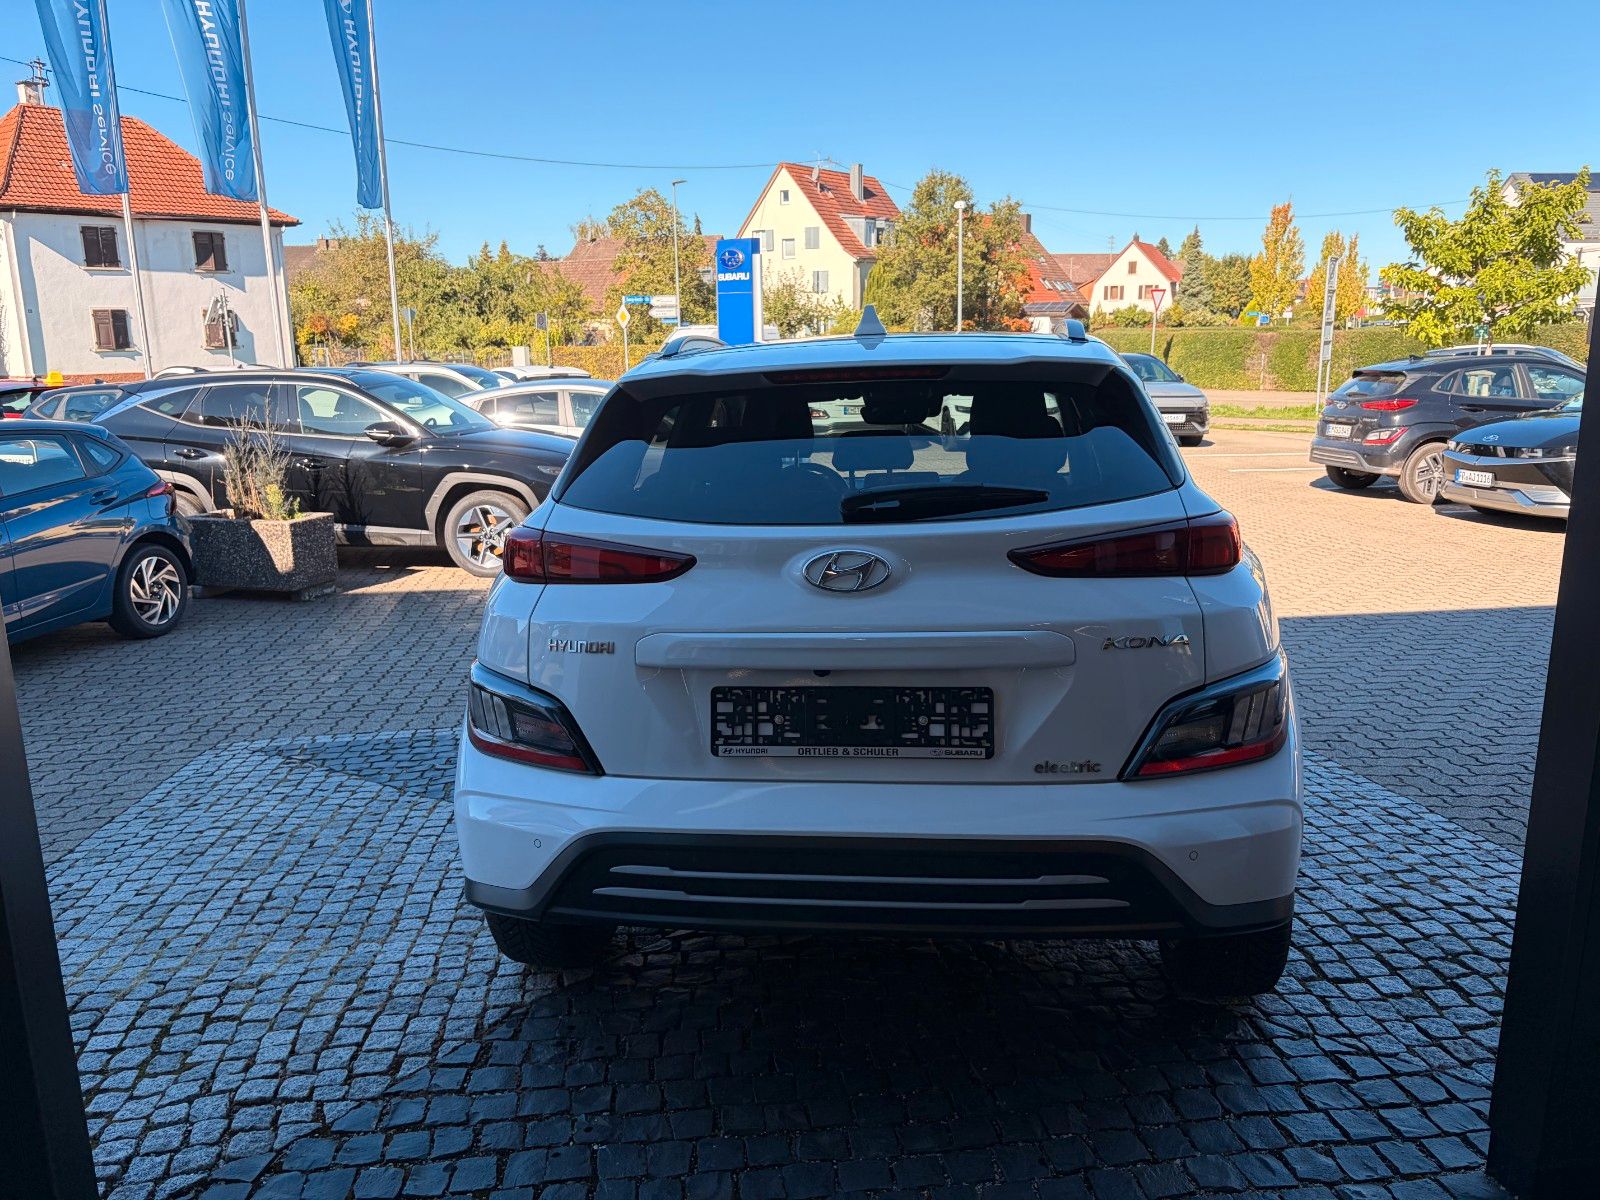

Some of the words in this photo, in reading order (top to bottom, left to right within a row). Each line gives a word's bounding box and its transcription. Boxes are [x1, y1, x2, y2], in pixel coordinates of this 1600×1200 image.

[718, 272, 750, 282] SUBARU
[548, 639, 615, 654] HYUNDAI
[1102, 634, 1192, 656] KONA
[798, 747, 839, 756] ORTLIEB
[842, 747, 850, 756] &
[853, 747, 899, 757] SCHULER
[1034, 760, 1101, 774] electric
